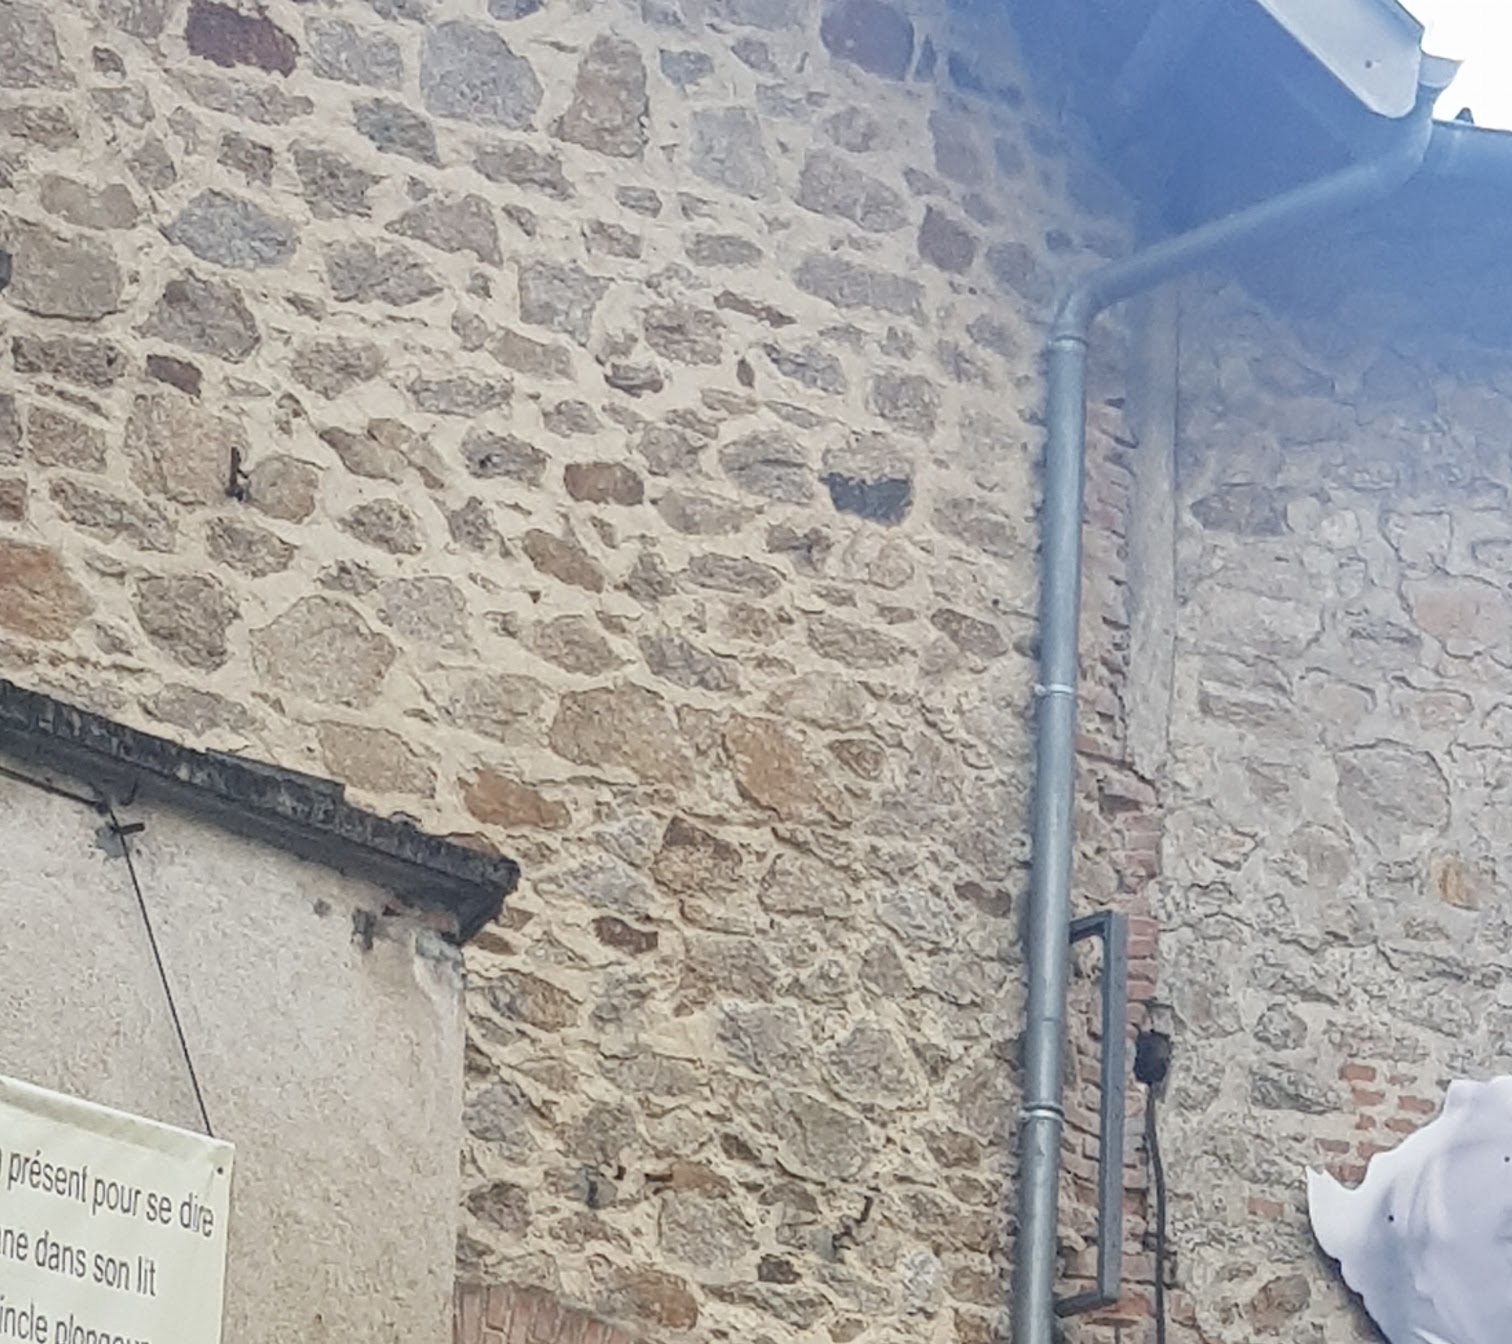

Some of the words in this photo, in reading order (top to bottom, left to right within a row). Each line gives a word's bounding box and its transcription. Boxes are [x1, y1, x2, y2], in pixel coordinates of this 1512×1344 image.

[7, 1150, 88, 1203] présent
[92, 1178, 142, 1216] pour
[146, 1192, 172, 1225] se
[180, 1192, 214, 1237] dire
[0, 1228, 28, 1261] ne
[35, 1230, 86, 1278] dans
[93, 1253, 130, 1291] son
[136, 1255, 156, 1297] lit
